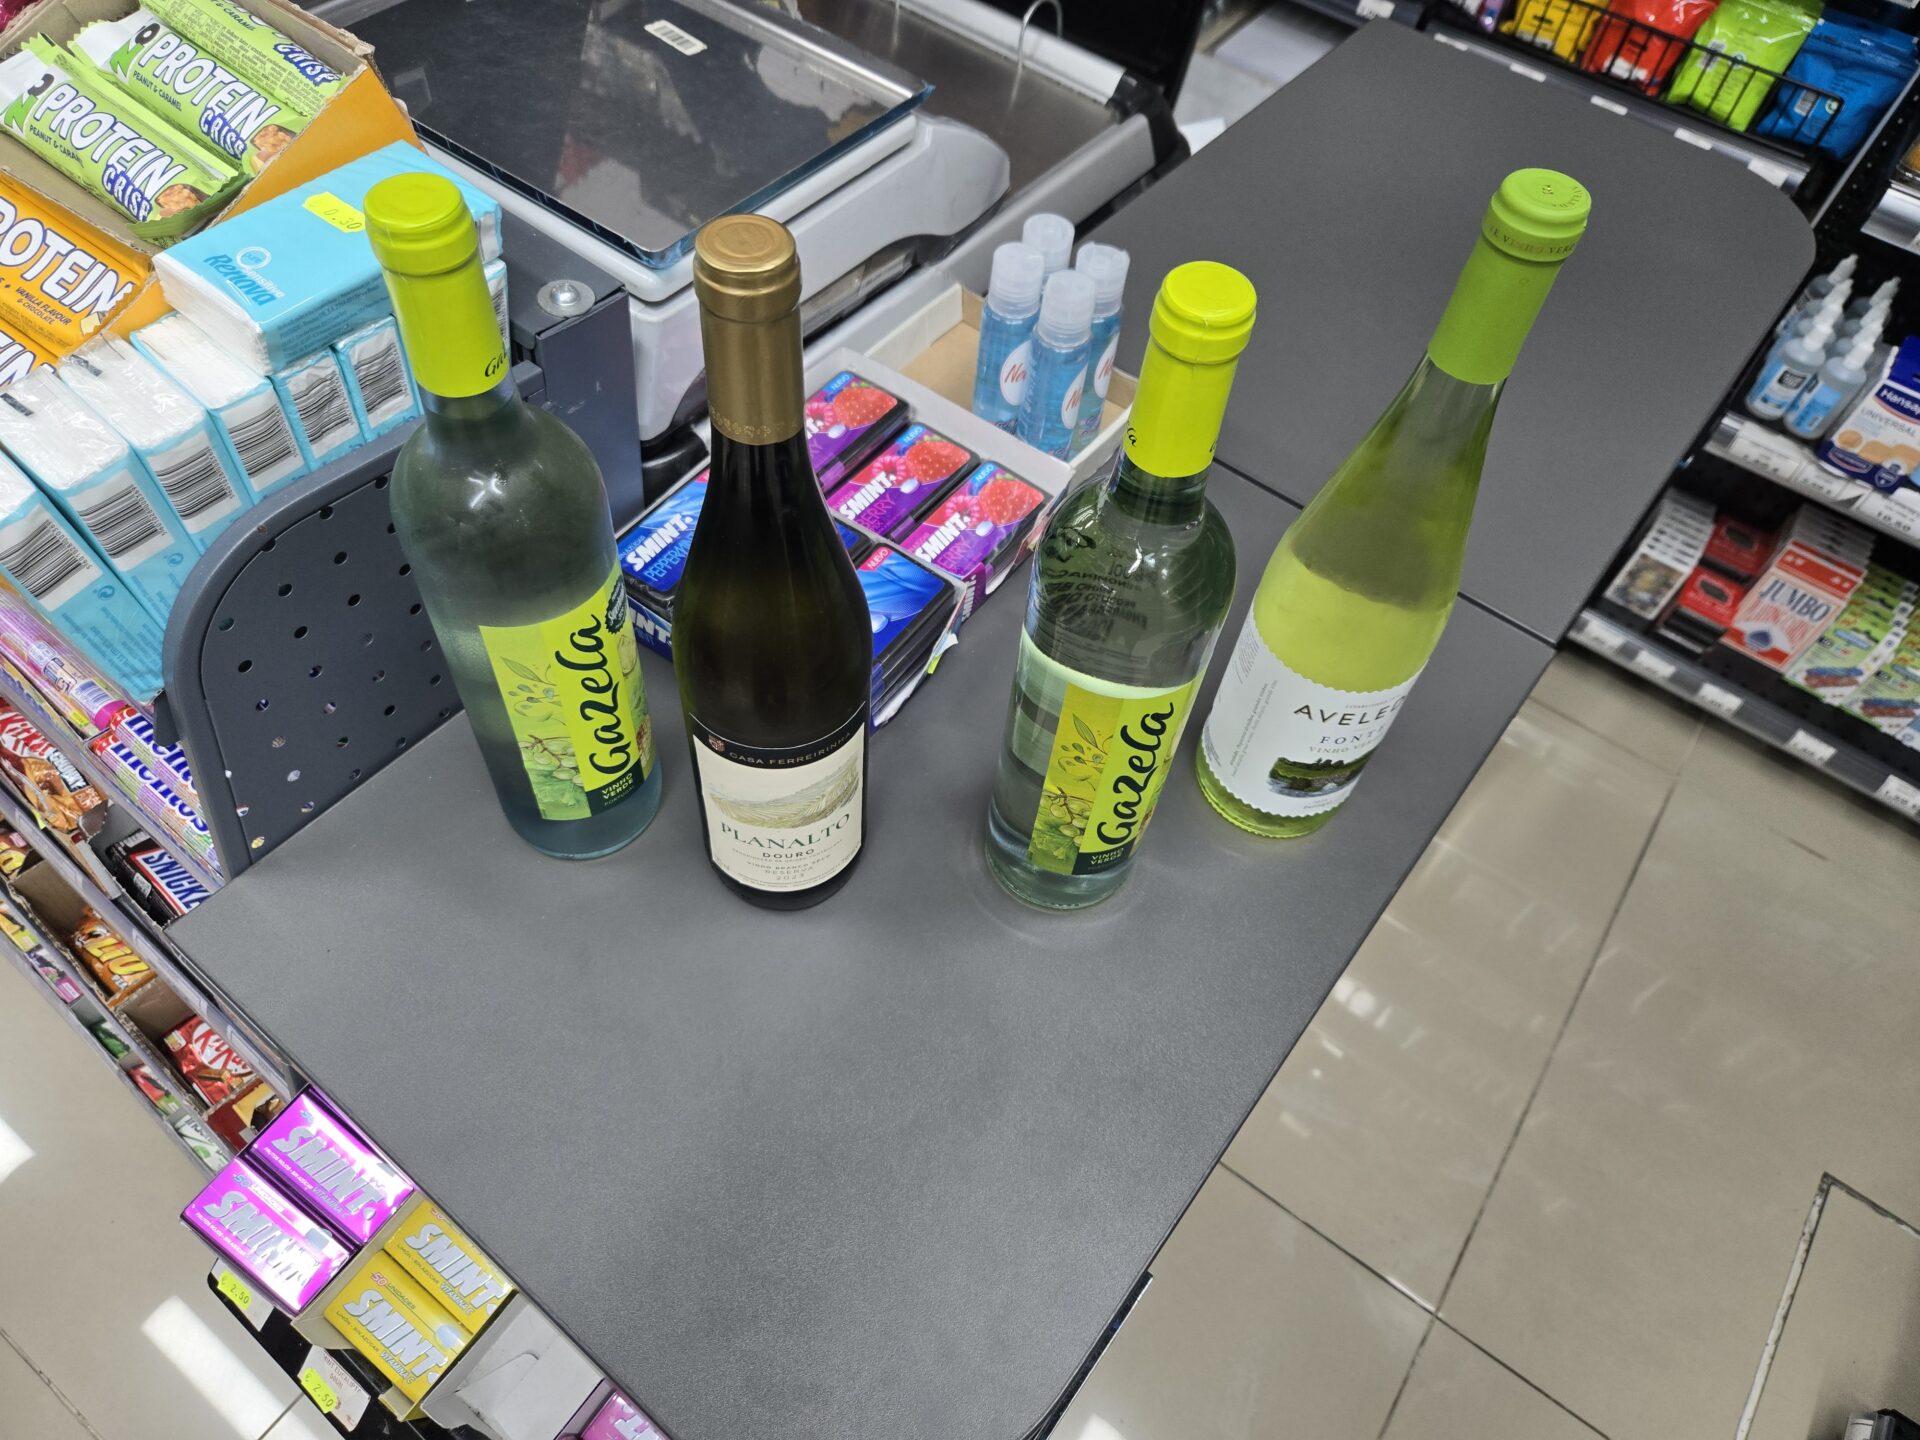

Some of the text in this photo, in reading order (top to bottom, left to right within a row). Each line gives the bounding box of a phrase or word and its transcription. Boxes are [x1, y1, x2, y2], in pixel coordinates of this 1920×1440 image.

[133, 69, 154, 90] PEANUT
[157, 88, 183, 112] CARAMEL
[138, 33, 282, 144] PROTEIN
[29, 124, 53, 145] PEANUT
[33, 82, 188, 200] PROTEIN
[203, 254, 278, 306] Renova
[15, 286, 72, 326] VANILLA FLAVOUR
[22, 300, 56, 326] CHOCOLATE
[832, 374, 851, 391] NUEVO
[904, 426, 924, 444] NUEVO
[1860, 407, 1918, 439] UNIVERSAL
[975, 464, 995, 483] NUEVO
[839, 471, 893, 521] SMINT
[626, 513, 689, 573] SMINT
[914, 511, 967, 564] SMINT
[867, 549, 889, 570] NUEVO
[937, 537, 971, 570] ERRY
[1758, 578, 1834, 625] JUMBO
[555, 613, 632, 775] Gazela
[729, 732, 851, 766] CASA FERREIRINHA
[601, 772, 633, 794] VINHO
[603, 777, 634, 800] VERDE
[1096, 702, 1176, 846] Gazela
[720, 812, 851, 850] PLANALTO
[762, 848, 815, 859] DOURO
[1091, 848, 1124, 861] VINHO
[764, 866, 815, 876] RESERVA
[233, 1174, 252, 1188] 50
[271, 1126, 386, 1216] SMINT
[370, 1272, 388, 1287] 50
[404, 1223, 508, 1310] SMINT
[229, 1283, 250, 1304] 2.50
[387, 1282, 416, 1310] UNIDADES
[439, 1282, 468, 1311] VITAMINA
[343, 1288, 449, 1377] SMINT
[379, 1350, 408, 1378] VITAMINA
[312, 1383, 334, 1408] 2.50
